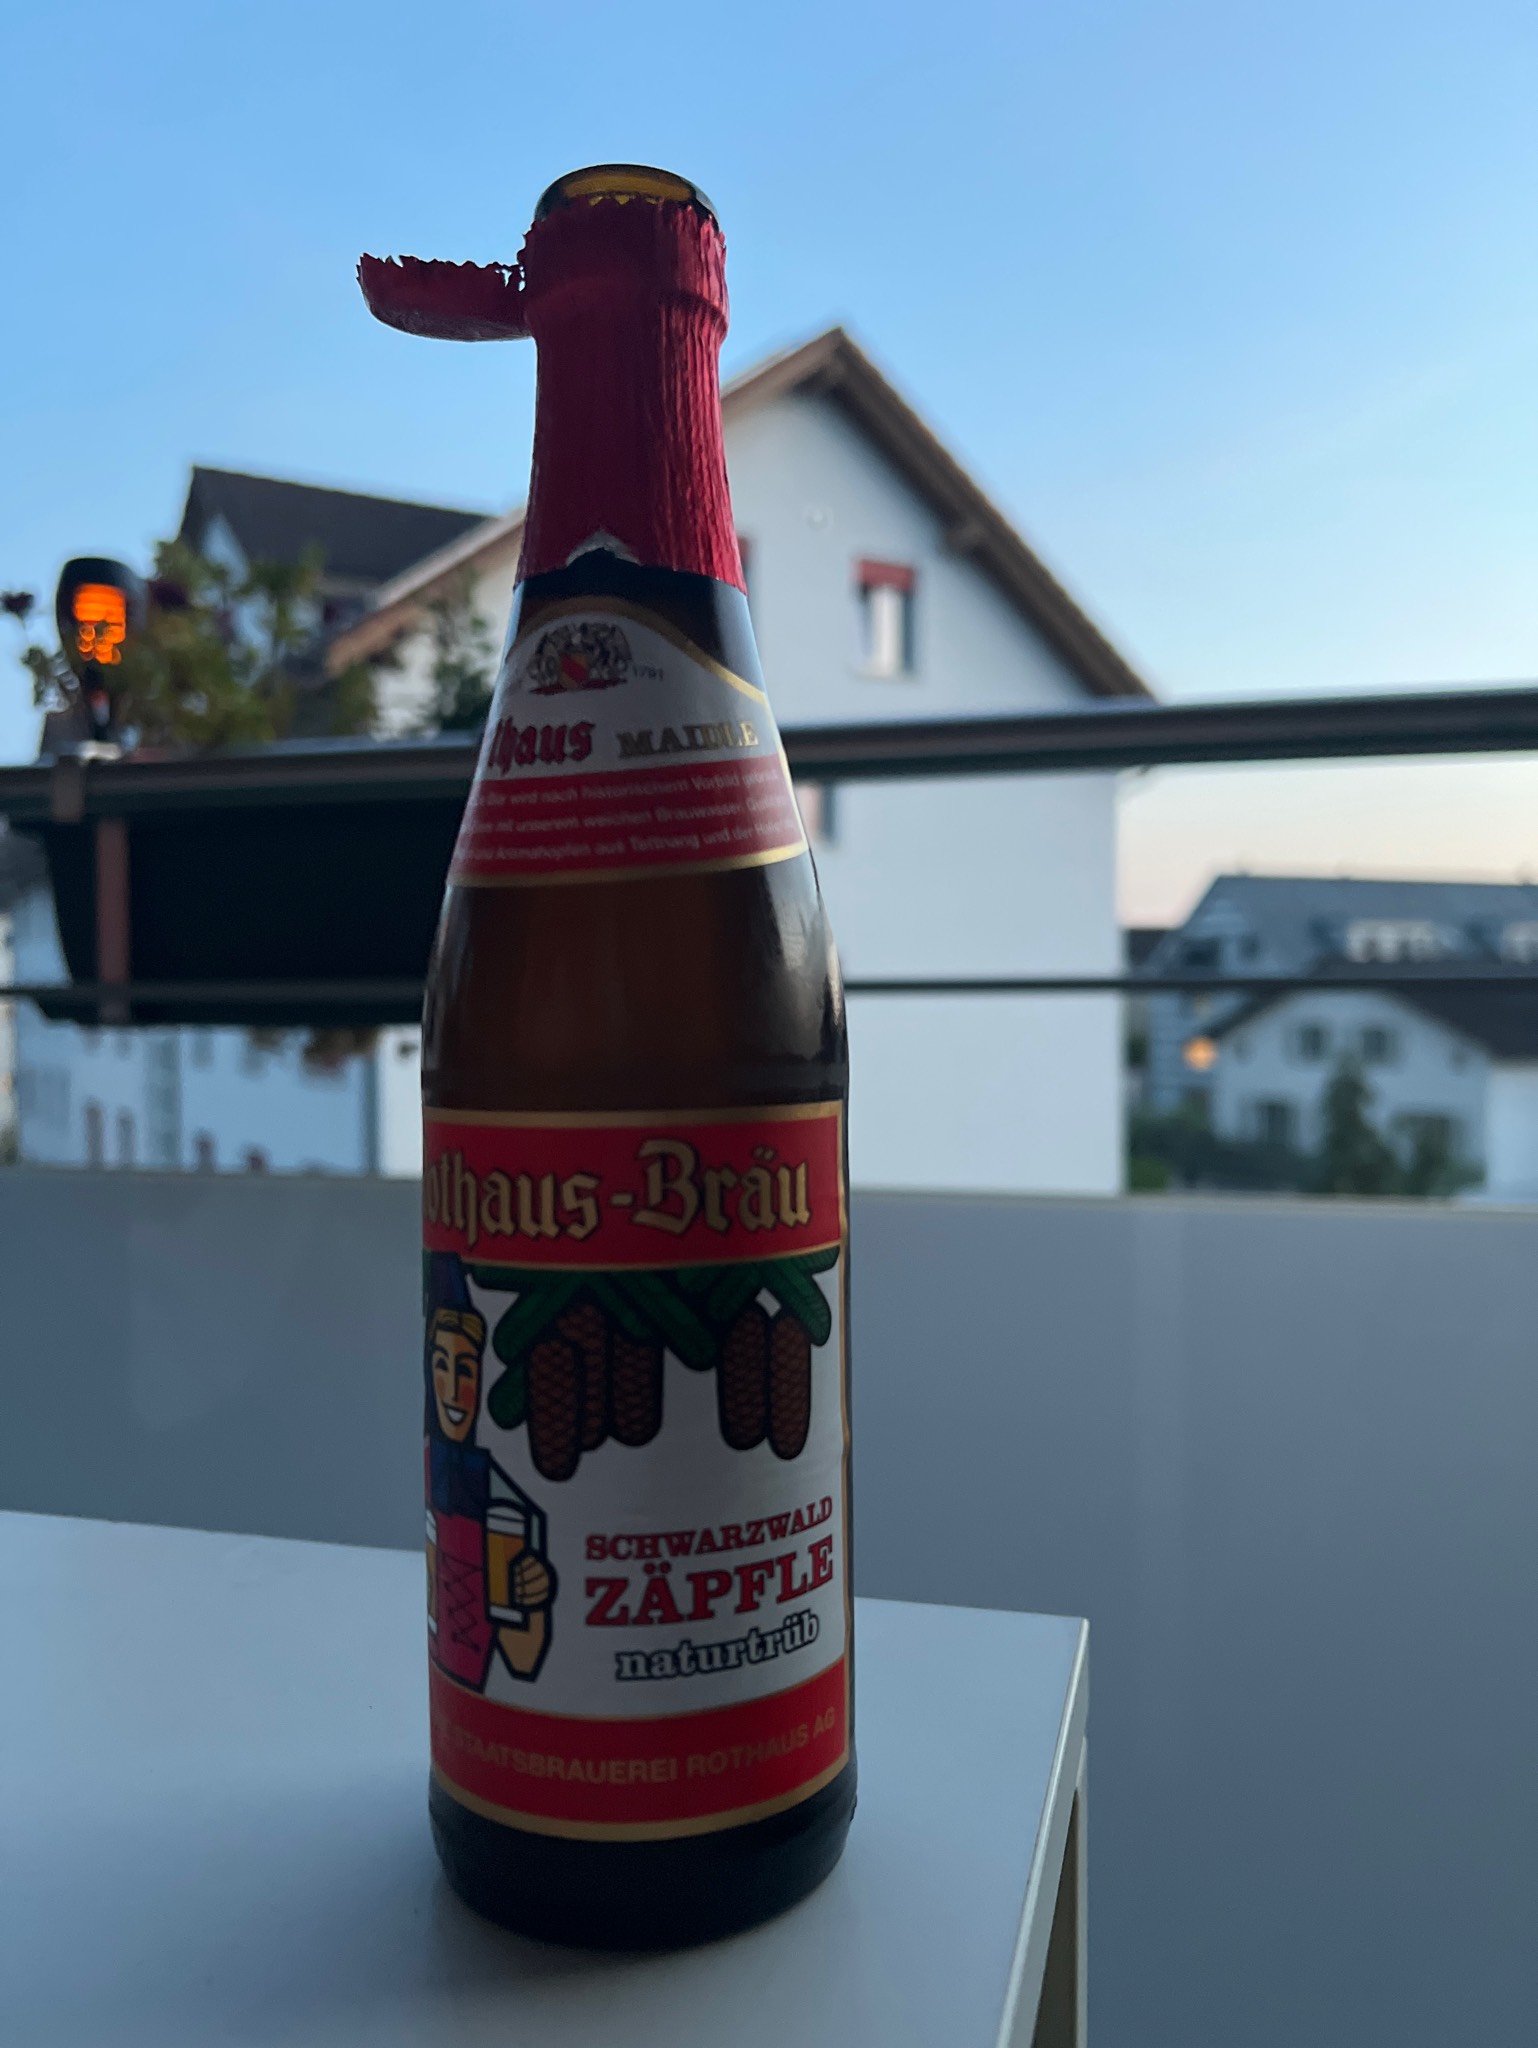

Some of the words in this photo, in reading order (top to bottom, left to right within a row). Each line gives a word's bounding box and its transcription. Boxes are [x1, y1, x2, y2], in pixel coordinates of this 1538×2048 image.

[616, 721, 760, 758] MAIDLE
[584, 1496, 833, 1561] SCHWARZWALD
[584, 1535, 834, 1628] ZÄPFLE
[615, 1608, 821, 1682] naturtrüb
[686, 1723, 809, 1778] ROTHAUS
[812, 1706, 836, 1739] AG
